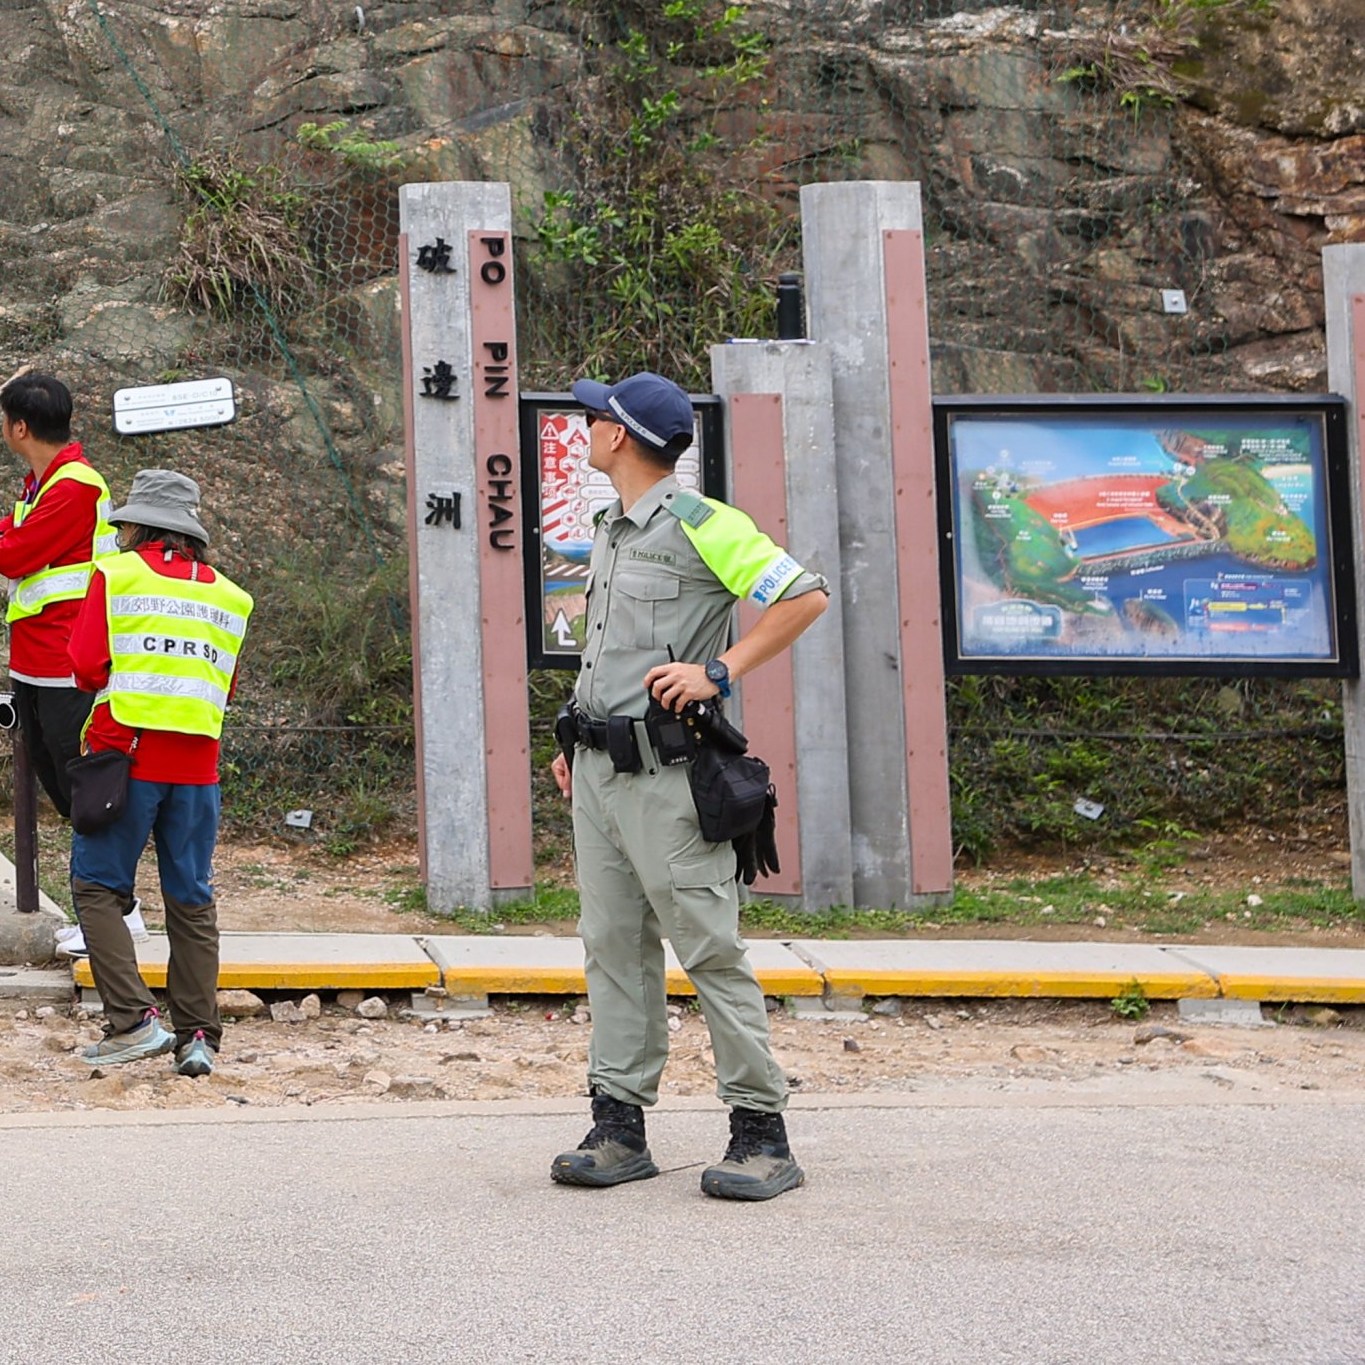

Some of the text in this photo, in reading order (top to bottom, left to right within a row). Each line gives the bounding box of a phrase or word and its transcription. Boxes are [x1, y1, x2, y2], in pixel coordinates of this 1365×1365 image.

[416, 238, 460, 529] 破邊洲
[480, 238, 514, 550] PO PIN CHAU
[758, 561, 792, 596] POLICE
